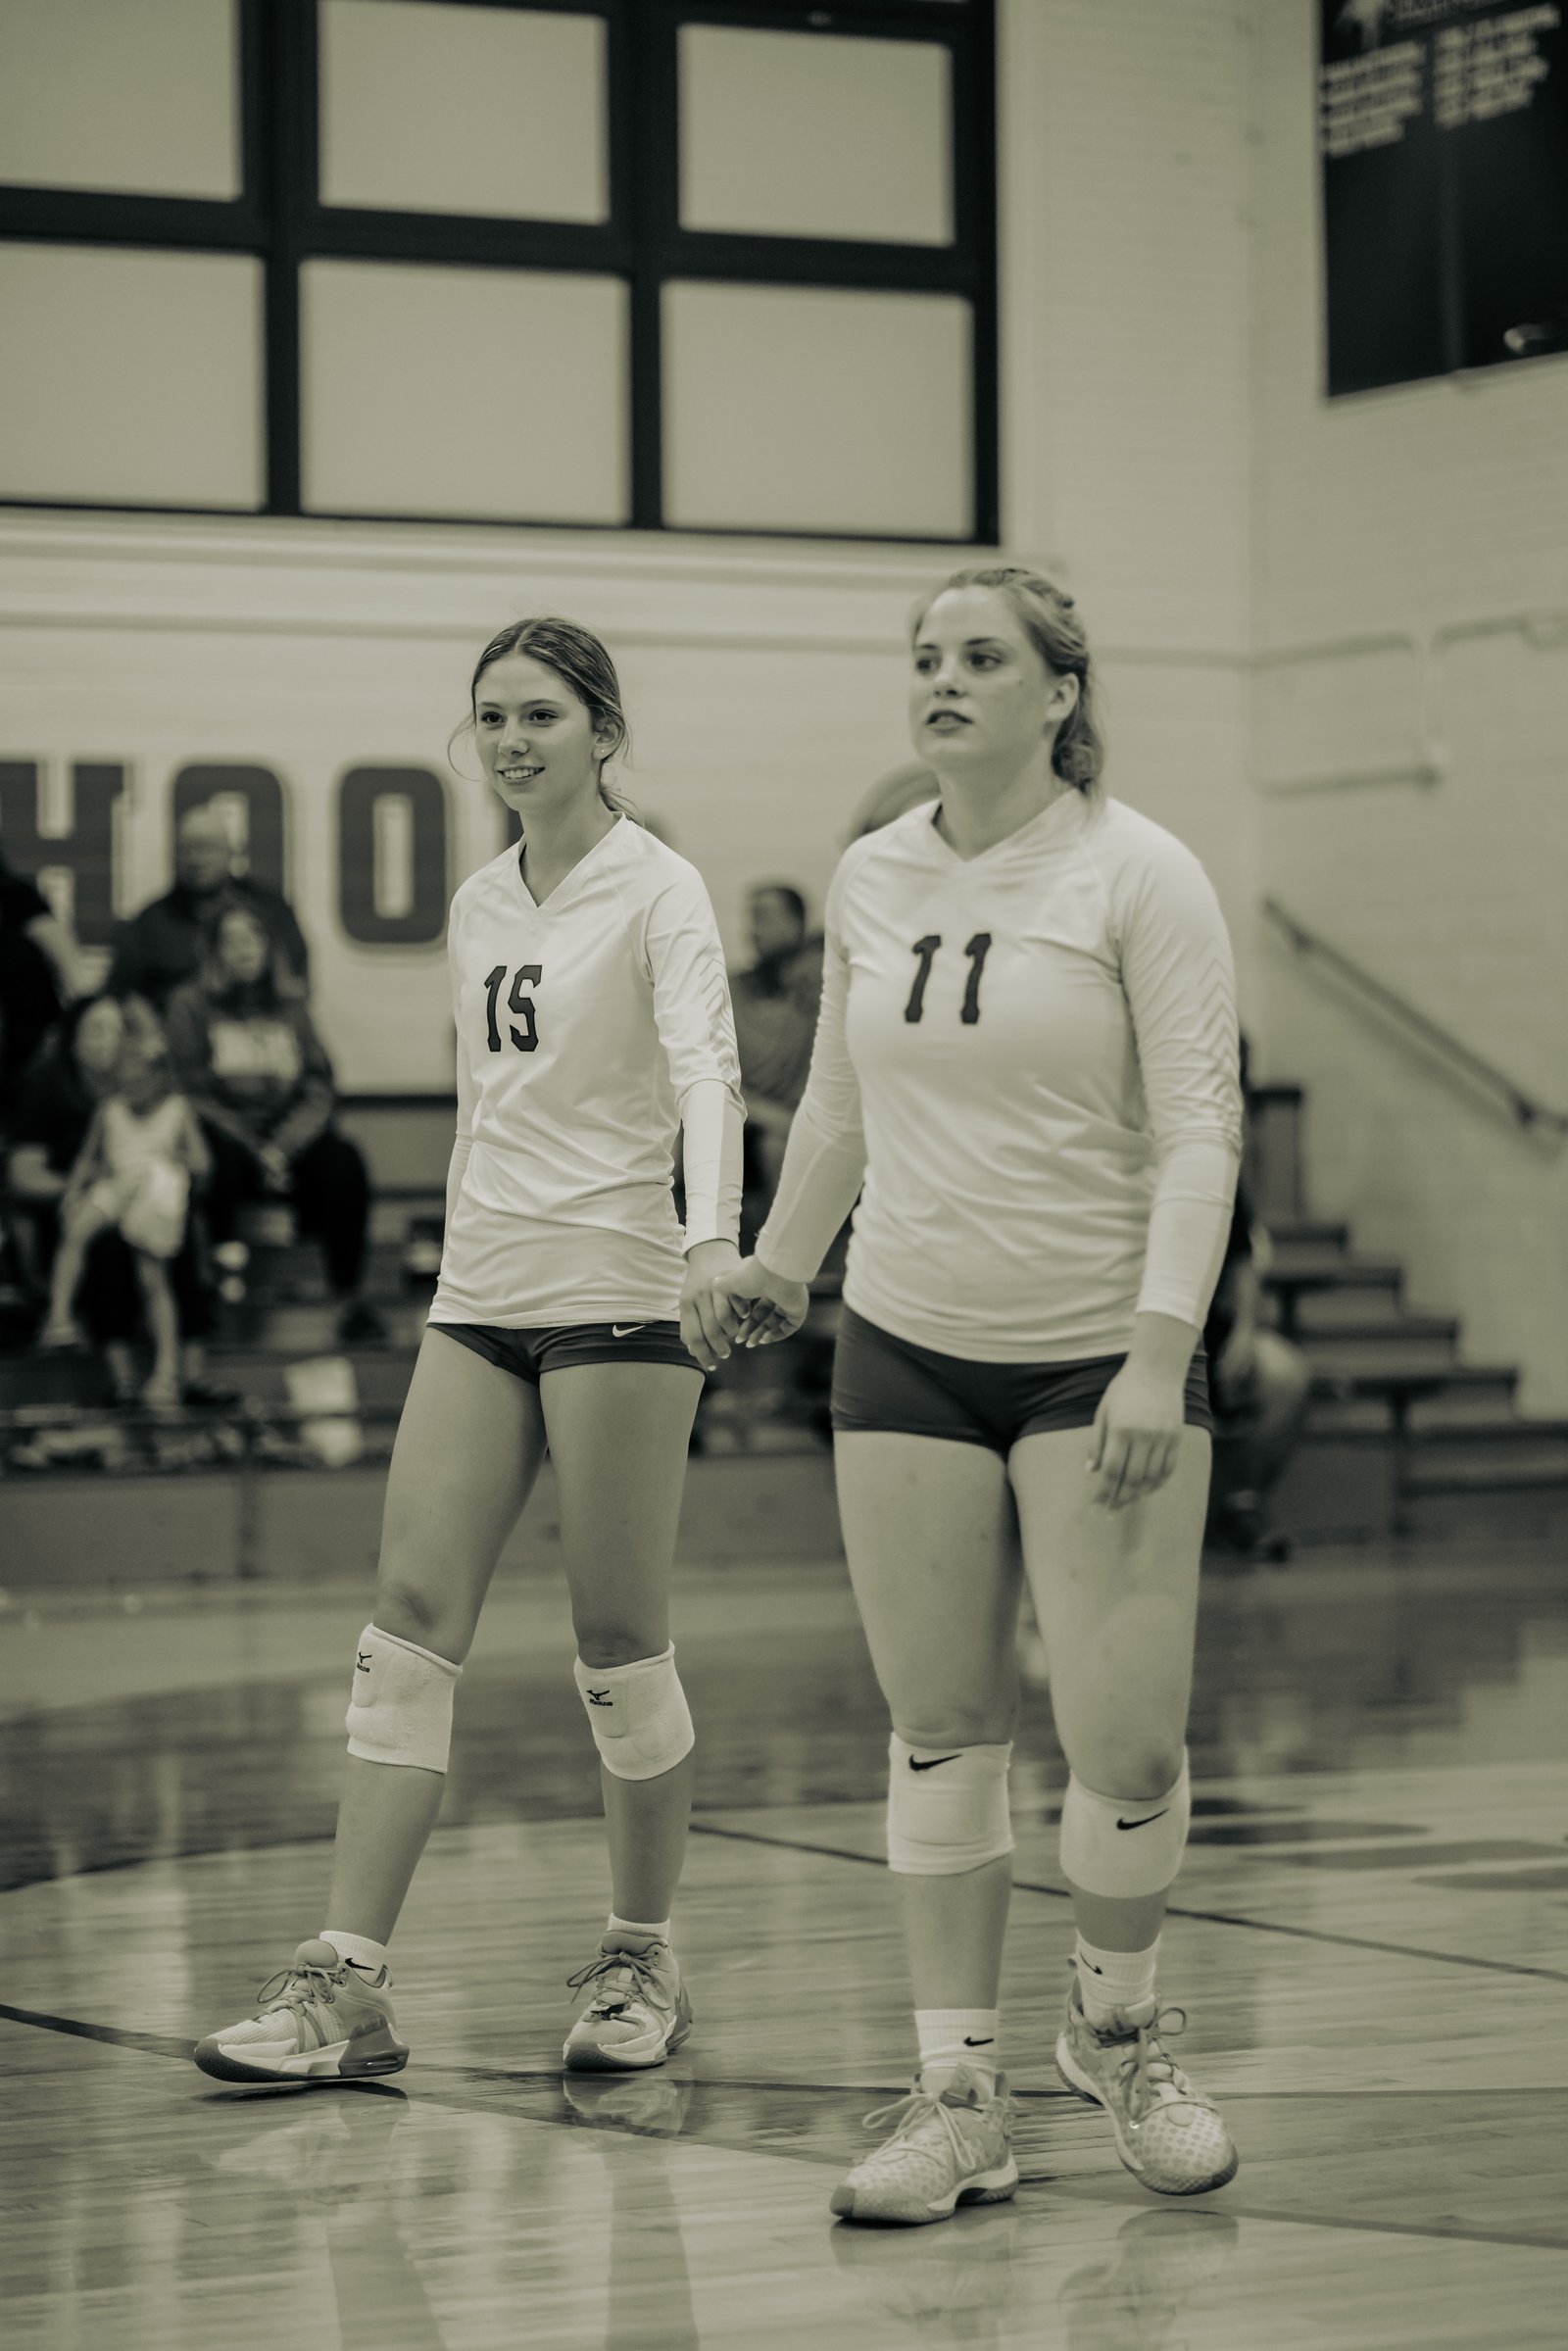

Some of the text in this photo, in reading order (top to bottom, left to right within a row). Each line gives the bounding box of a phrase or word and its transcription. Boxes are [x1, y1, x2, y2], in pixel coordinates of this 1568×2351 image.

[0, 761, 523, 946] HOO
[484, 965, 542, 1053] 15
[905, 933, 992, 1024] 11
